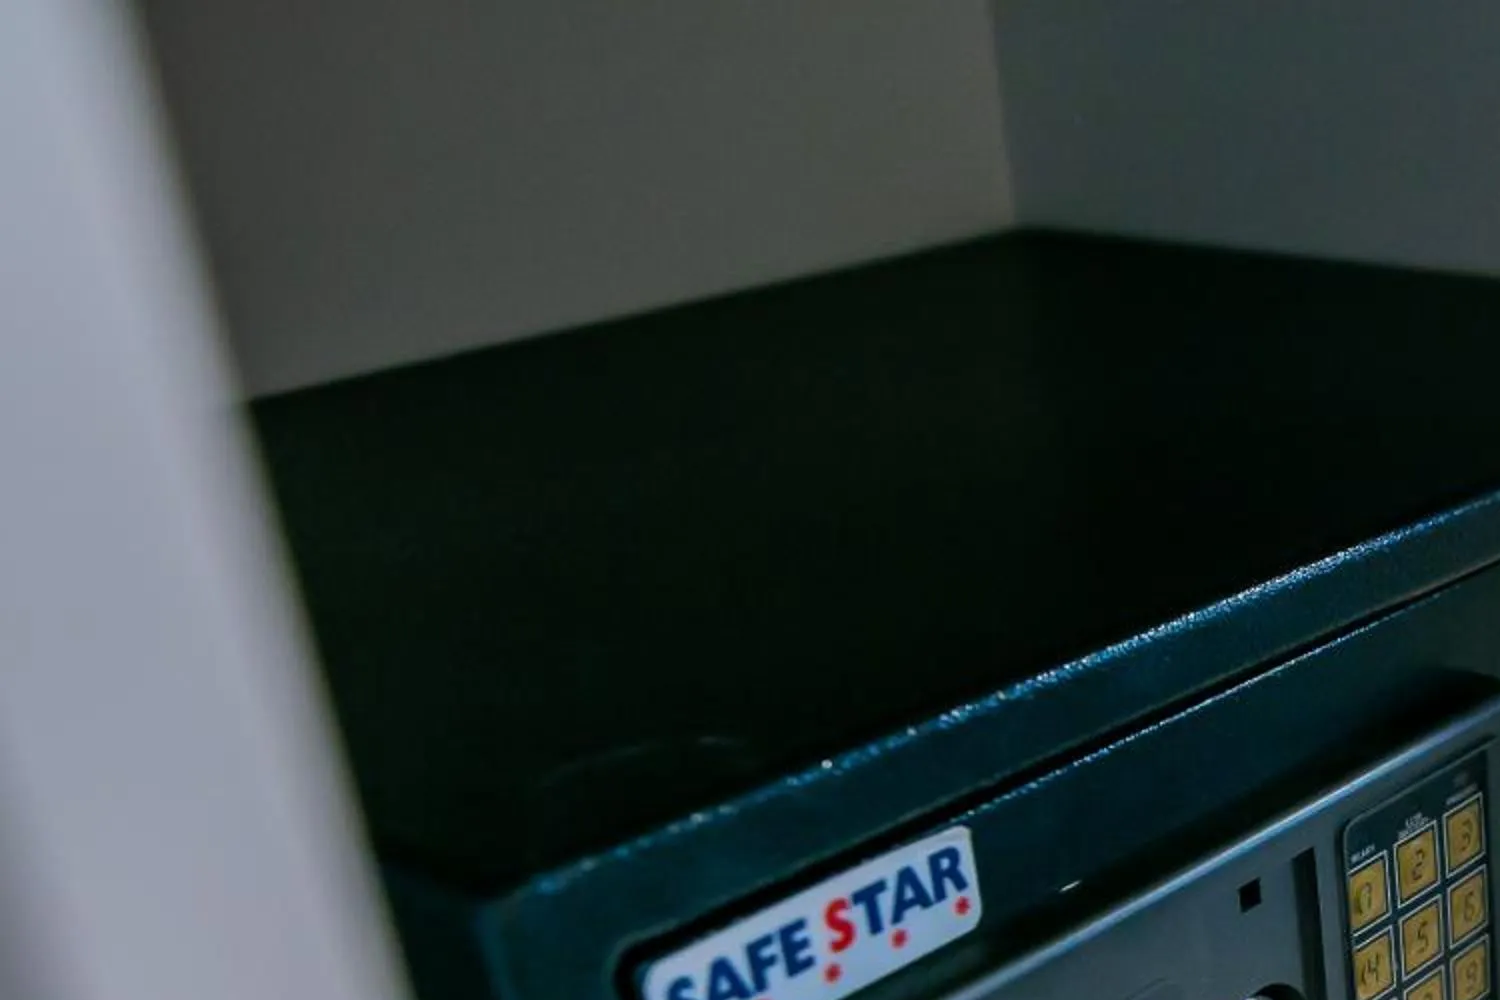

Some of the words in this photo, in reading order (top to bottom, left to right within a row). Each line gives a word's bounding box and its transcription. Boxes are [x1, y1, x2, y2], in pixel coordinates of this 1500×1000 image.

[1412, 848, 1425, 881] 2
[1461, 817, 1474, 852] 3
[824, 845, 969, 953] STAR
[1416, 920, 1429, 953] 5
[1464, 890, 1477, 921] 6
[1466, 960, 1478, 993] 9
